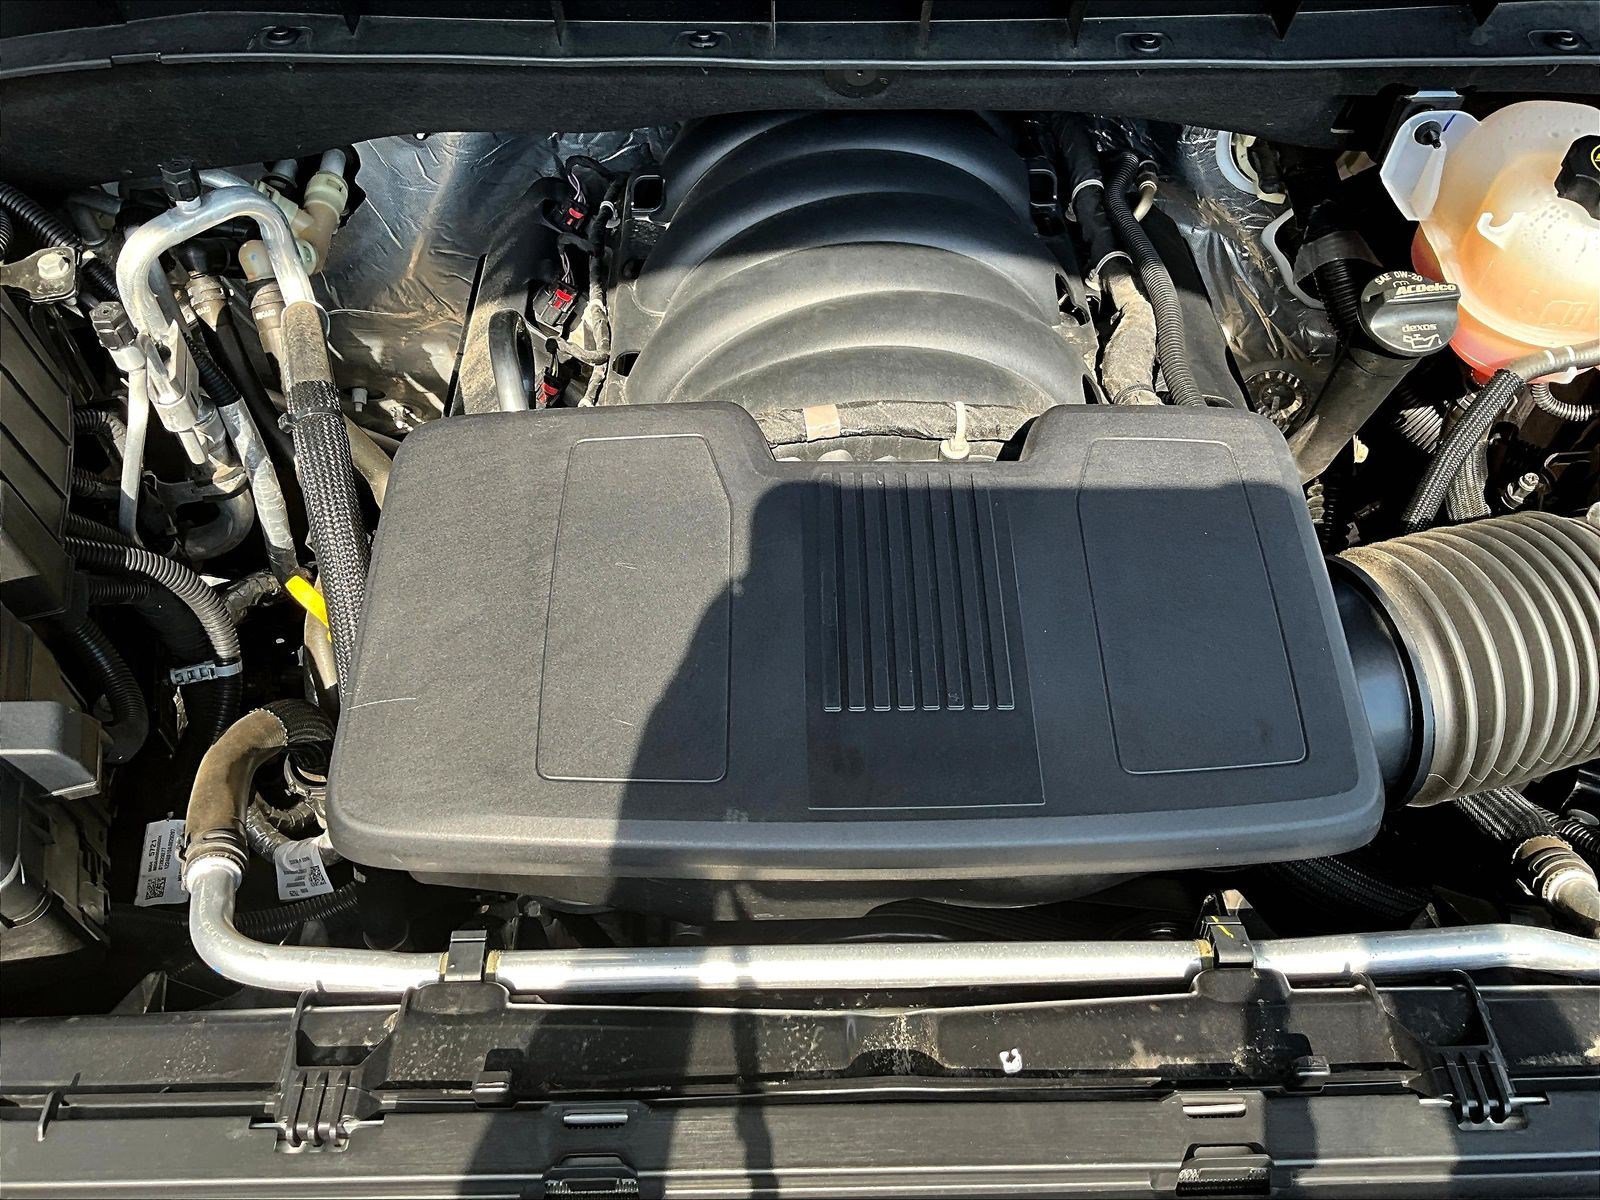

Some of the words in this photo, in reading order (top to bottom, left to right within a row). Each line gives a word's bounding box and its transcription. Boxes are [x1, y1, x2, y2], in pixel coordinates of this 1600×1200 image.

[1374, 273, 1392, 286] SAE
[1393, 270, 1423, 282] 0W-20
[1395, 283, 1457, 296] ACDelco
[1402, 323, 1438, 333] dexos
